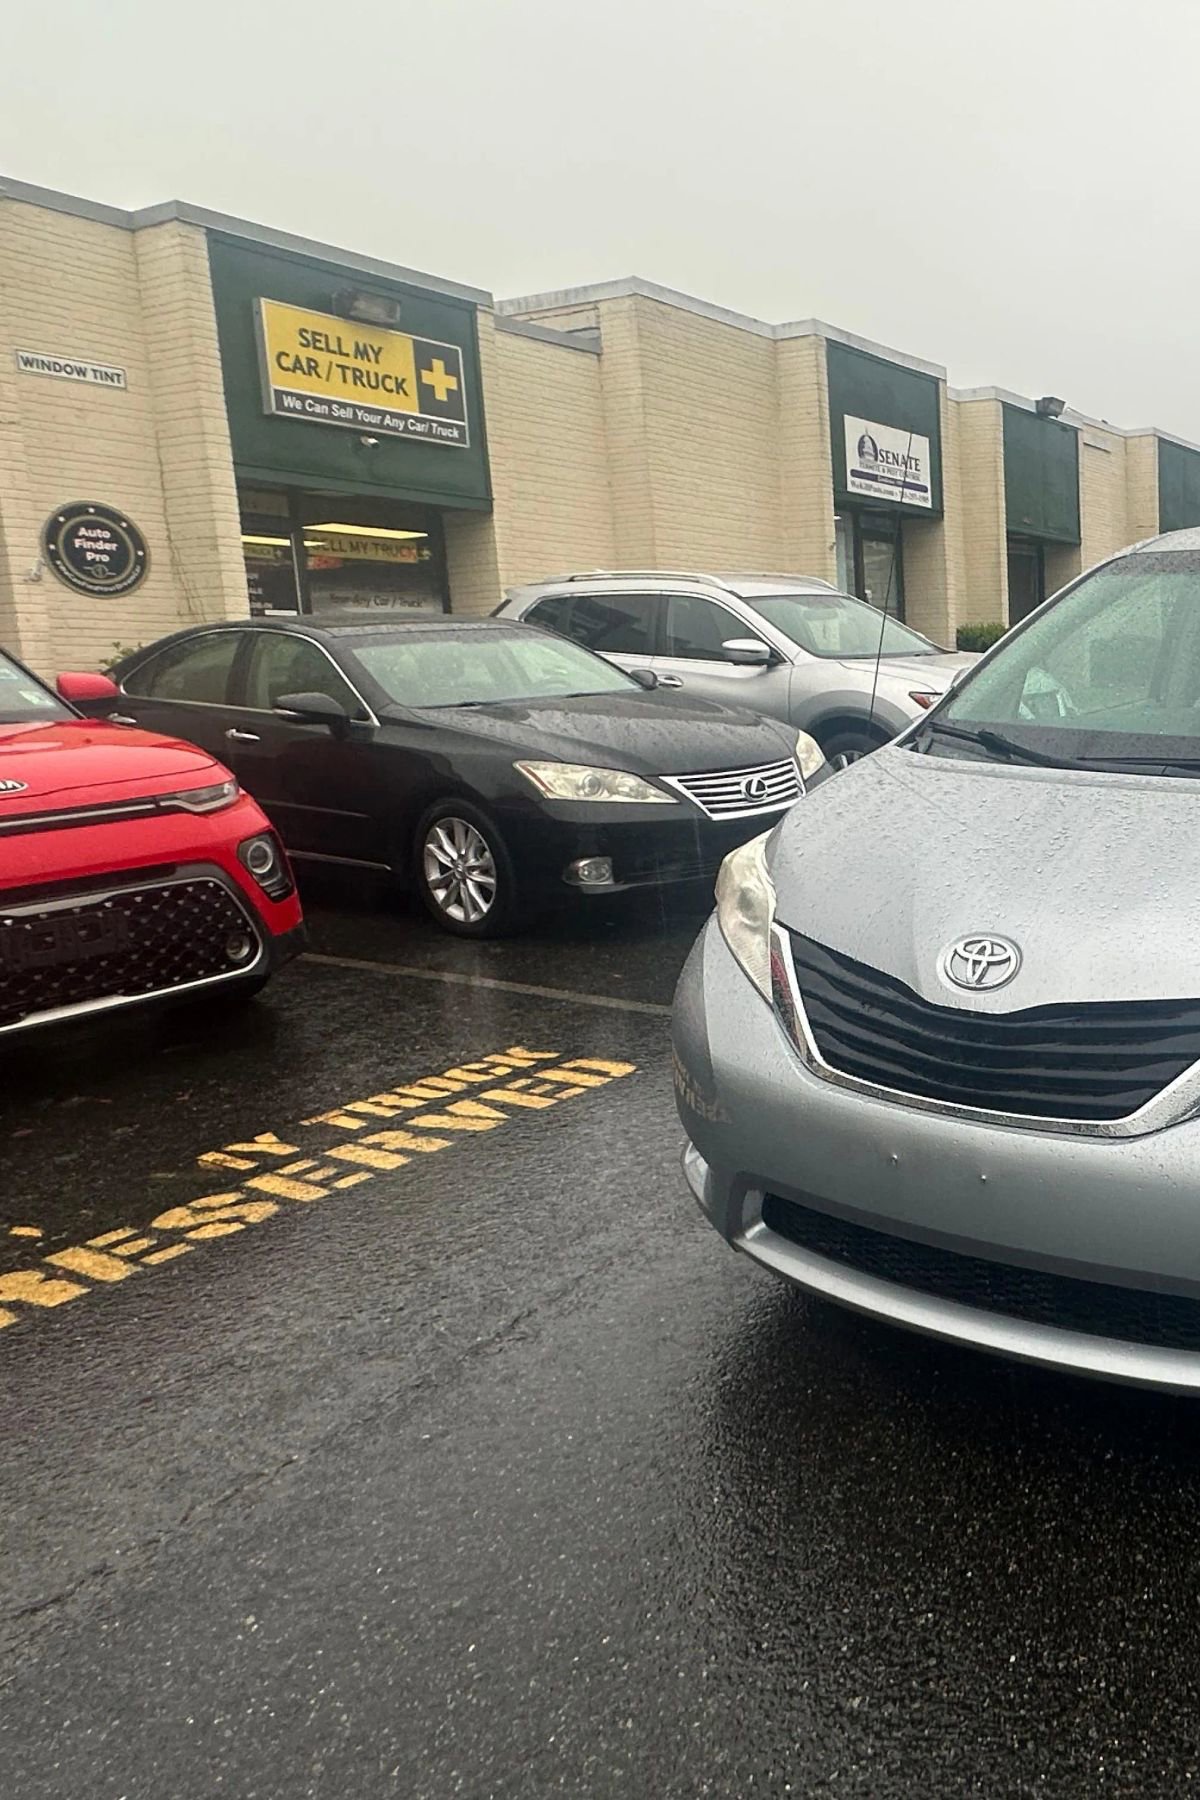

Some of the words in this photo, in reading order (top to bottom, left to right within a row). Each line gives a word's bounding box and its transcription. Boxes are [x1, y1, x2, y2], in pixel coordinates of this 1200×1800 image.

[298, 327, 350, 358] SELL
[353, 341, 384, 365] MY
[20, 355, 88, 378] WINDOW
[90, 368, 122, 384] TINT
[335, 364, 409, 397] TRUCK
[282, 395, 303, 410] We
[305, 399, 329, 415] Can
[331, 404, 353, 420] Sell
[355, 409, 383, 425] Your
[383, 414, 405, 431] Any
[431, 423, 460, 439] Truck
[878, 448, 921, 472] SENATE
[73, 538, 119, 551] Finder
[78, 527, 111, 539] Auto
[85, 551, 110, 562] Pro
[349, 541, 369, 554] MY
[301, 1046, 559, 1131] TRUCK
